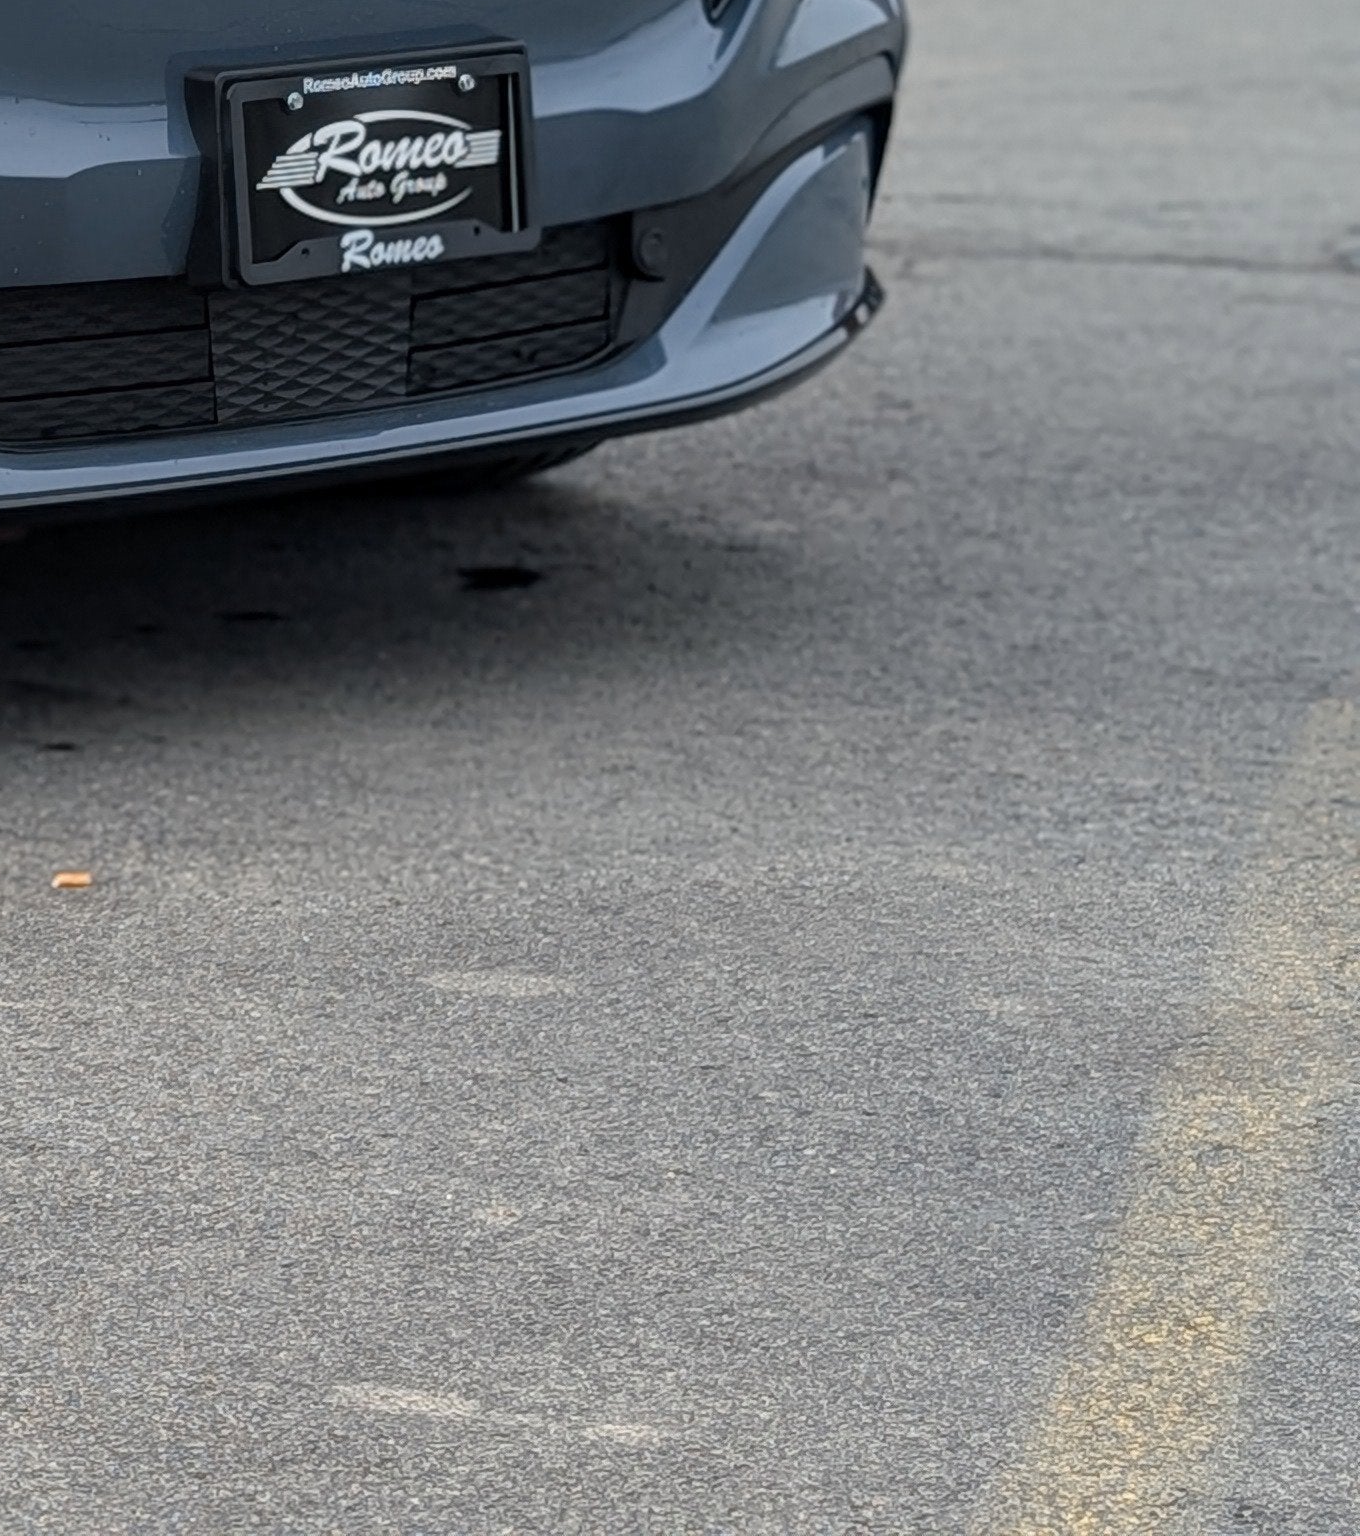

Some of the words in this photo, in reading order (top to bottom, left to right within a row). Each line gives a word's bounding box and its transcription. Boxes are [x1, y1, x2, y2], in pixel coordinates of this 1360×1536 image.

[302, 65, 458, 95] RomeoAutoGroup.com
[313, 119, 469, 184] Romeo
[336, 177, 386, 205] Auto
[390, 170, 448, 205] Group
[339, 228, 445, 273] Romeo
